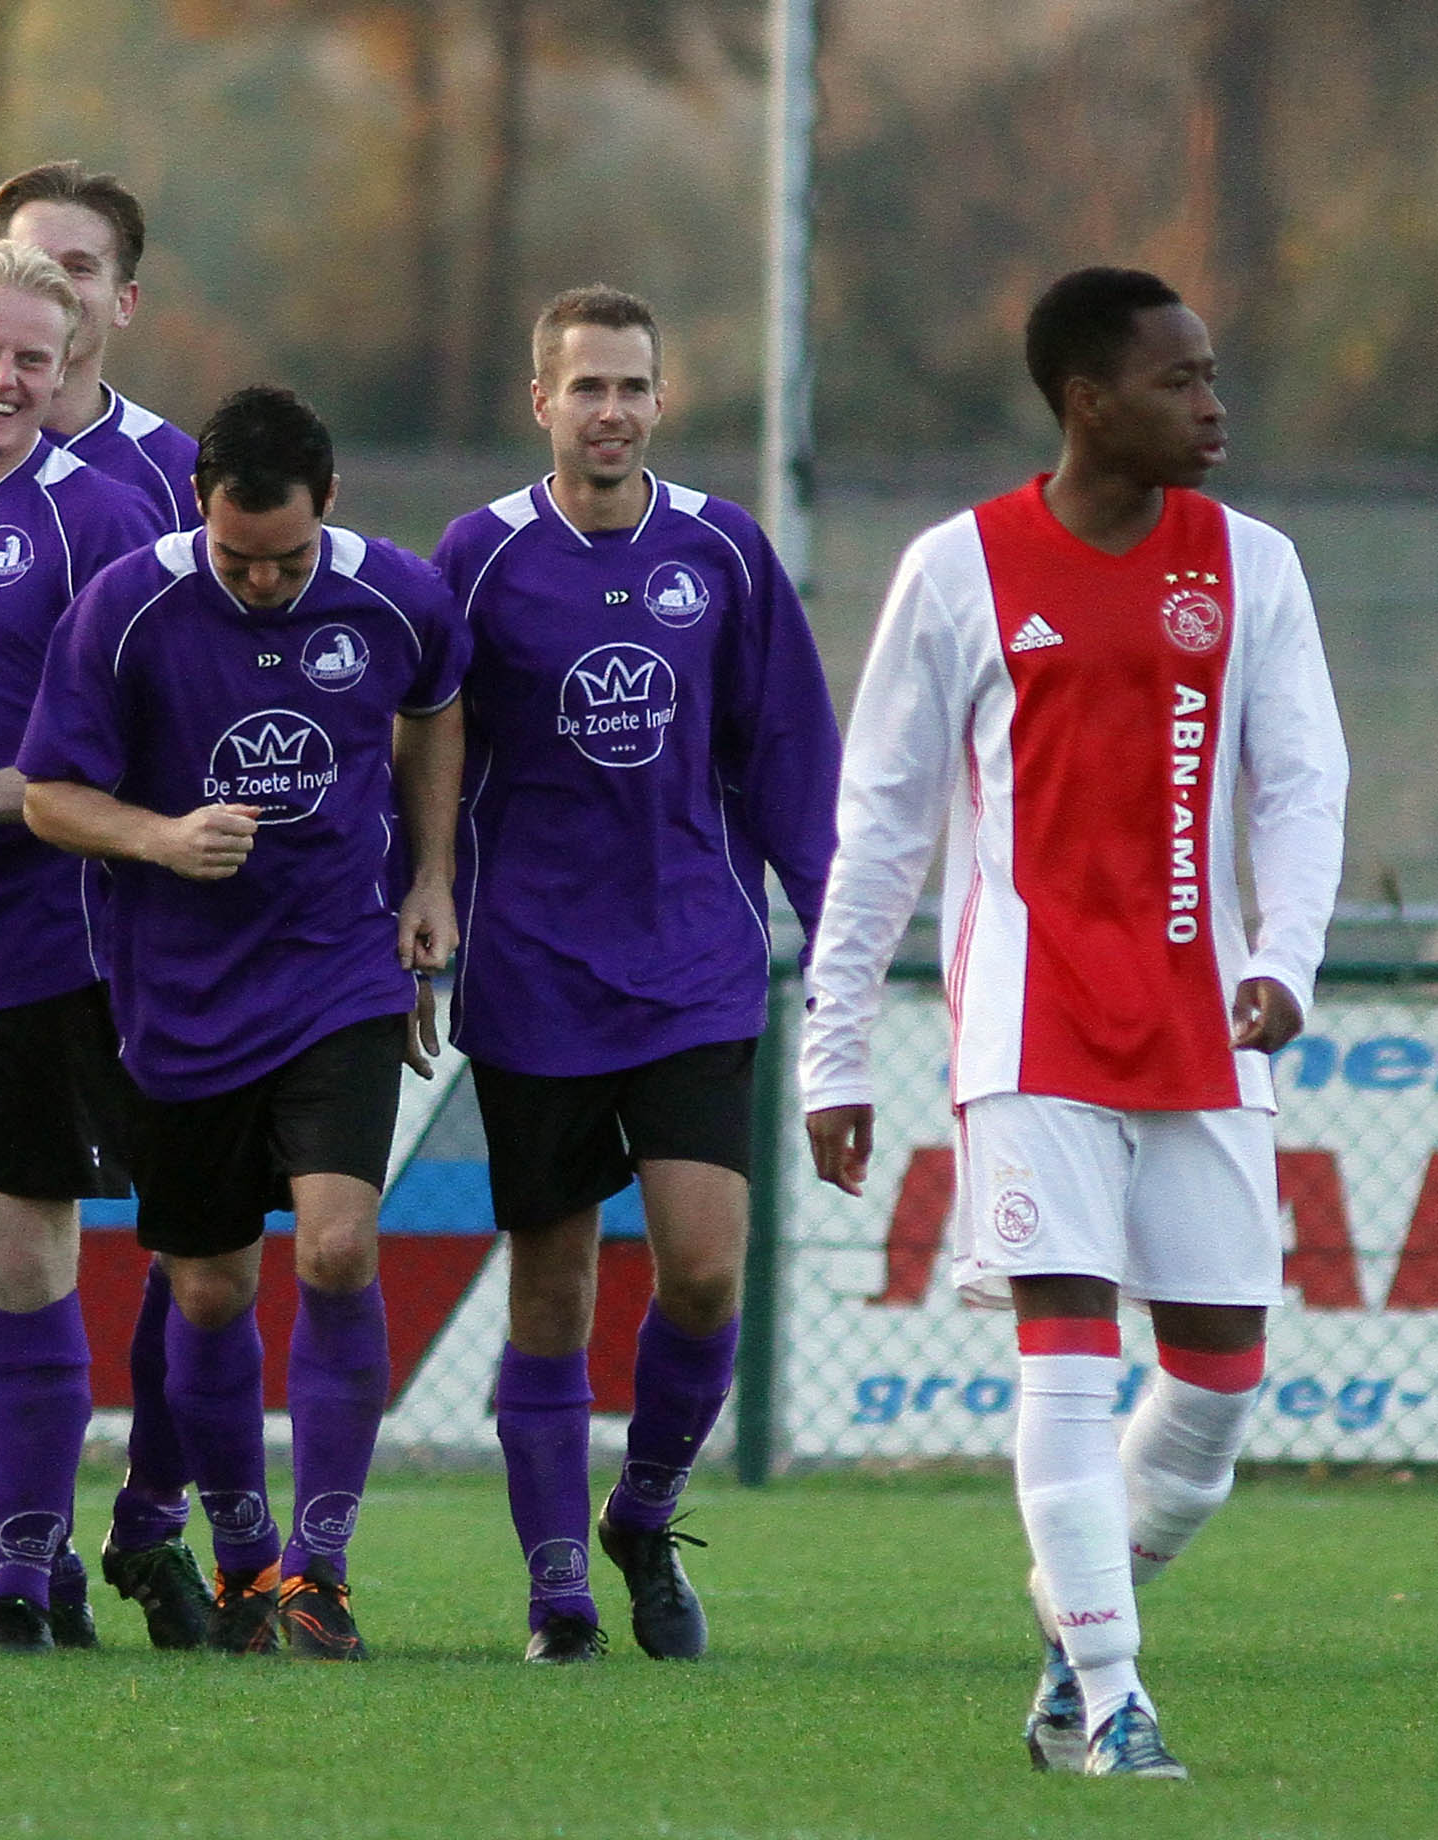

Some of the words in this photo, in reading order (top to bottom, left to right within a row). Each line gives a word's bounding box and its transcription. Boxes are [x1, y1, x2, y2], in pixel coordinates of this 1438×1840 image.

[1009, 633, 1064, 653] adidas
[557, 715, 580, 735] De
[585, 710, 640, 735] Zoete
[203, 778, 230, 797] De
[236, 772, 291, 795] Zoete
[297, 763, 338, 790] Inval
